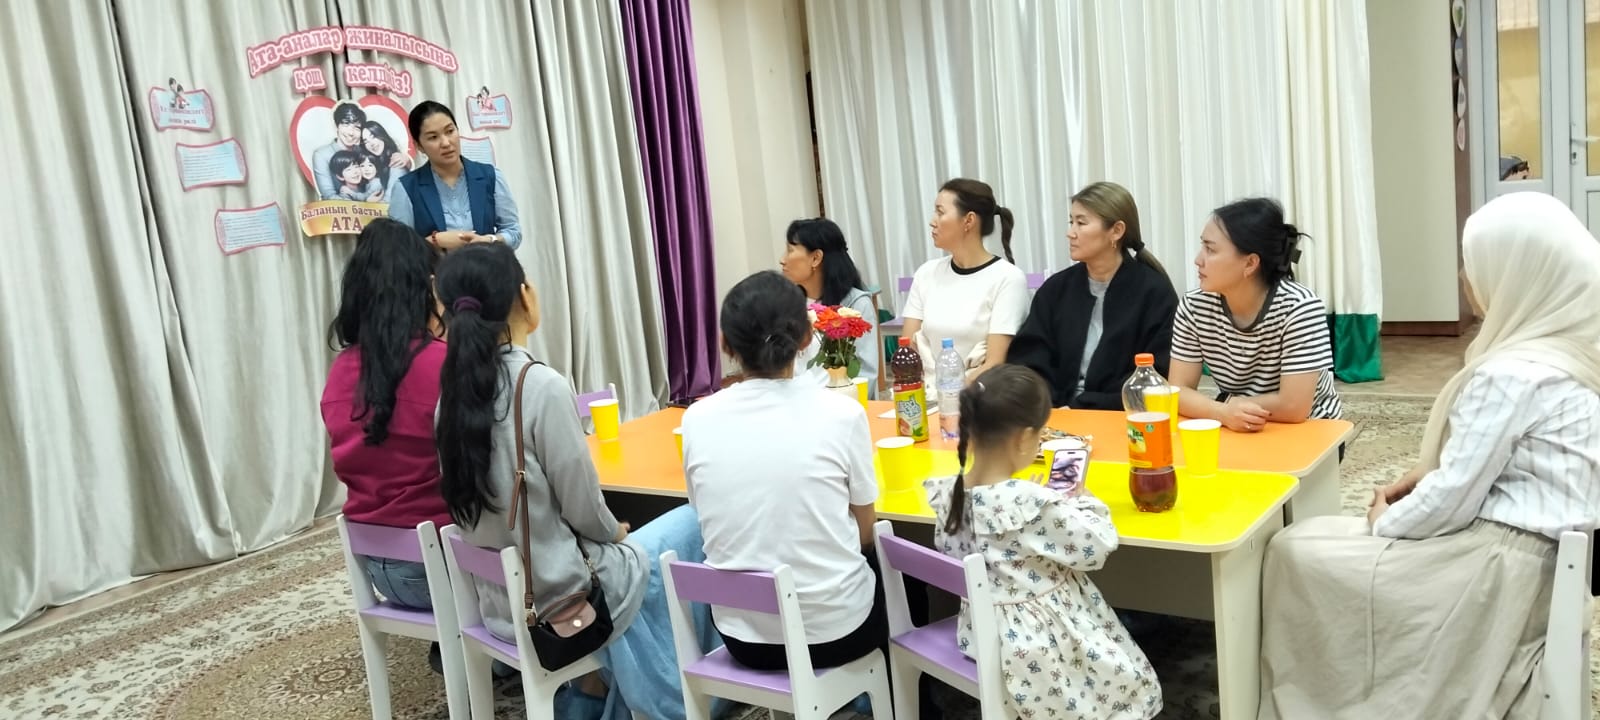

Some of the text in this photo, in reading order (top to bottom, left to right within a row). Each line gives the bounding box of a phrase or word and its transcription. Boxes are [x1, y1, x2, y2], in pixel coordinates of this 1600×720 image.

[248, 30, 455, 71] Ата-аналар жиналысына
[352, 205, 382, 217] басты
[331, 216, 362, 232] АТА
